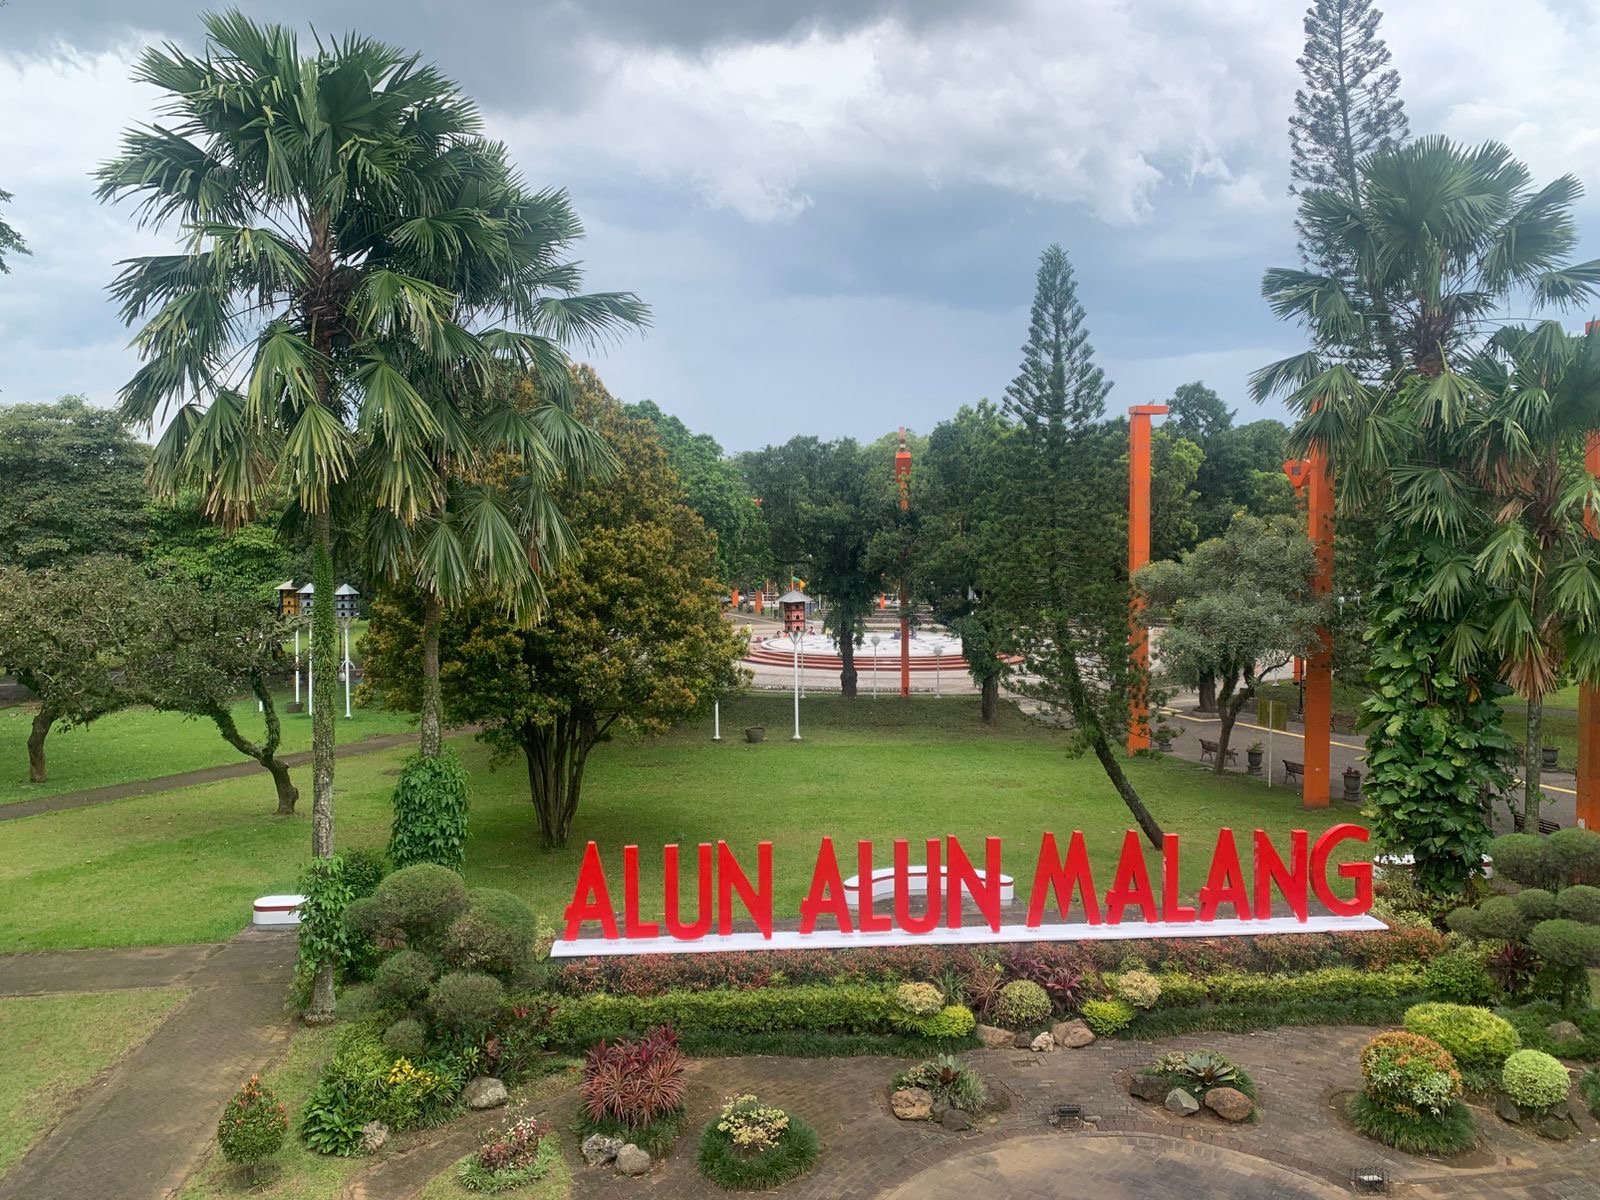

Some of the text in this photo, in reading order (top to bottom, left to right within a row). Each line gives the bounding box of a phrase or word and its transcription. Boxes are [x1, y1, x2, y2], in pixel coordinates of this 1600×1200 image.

[564, 824, 1374, 940] ALUN ALUN MALANG
